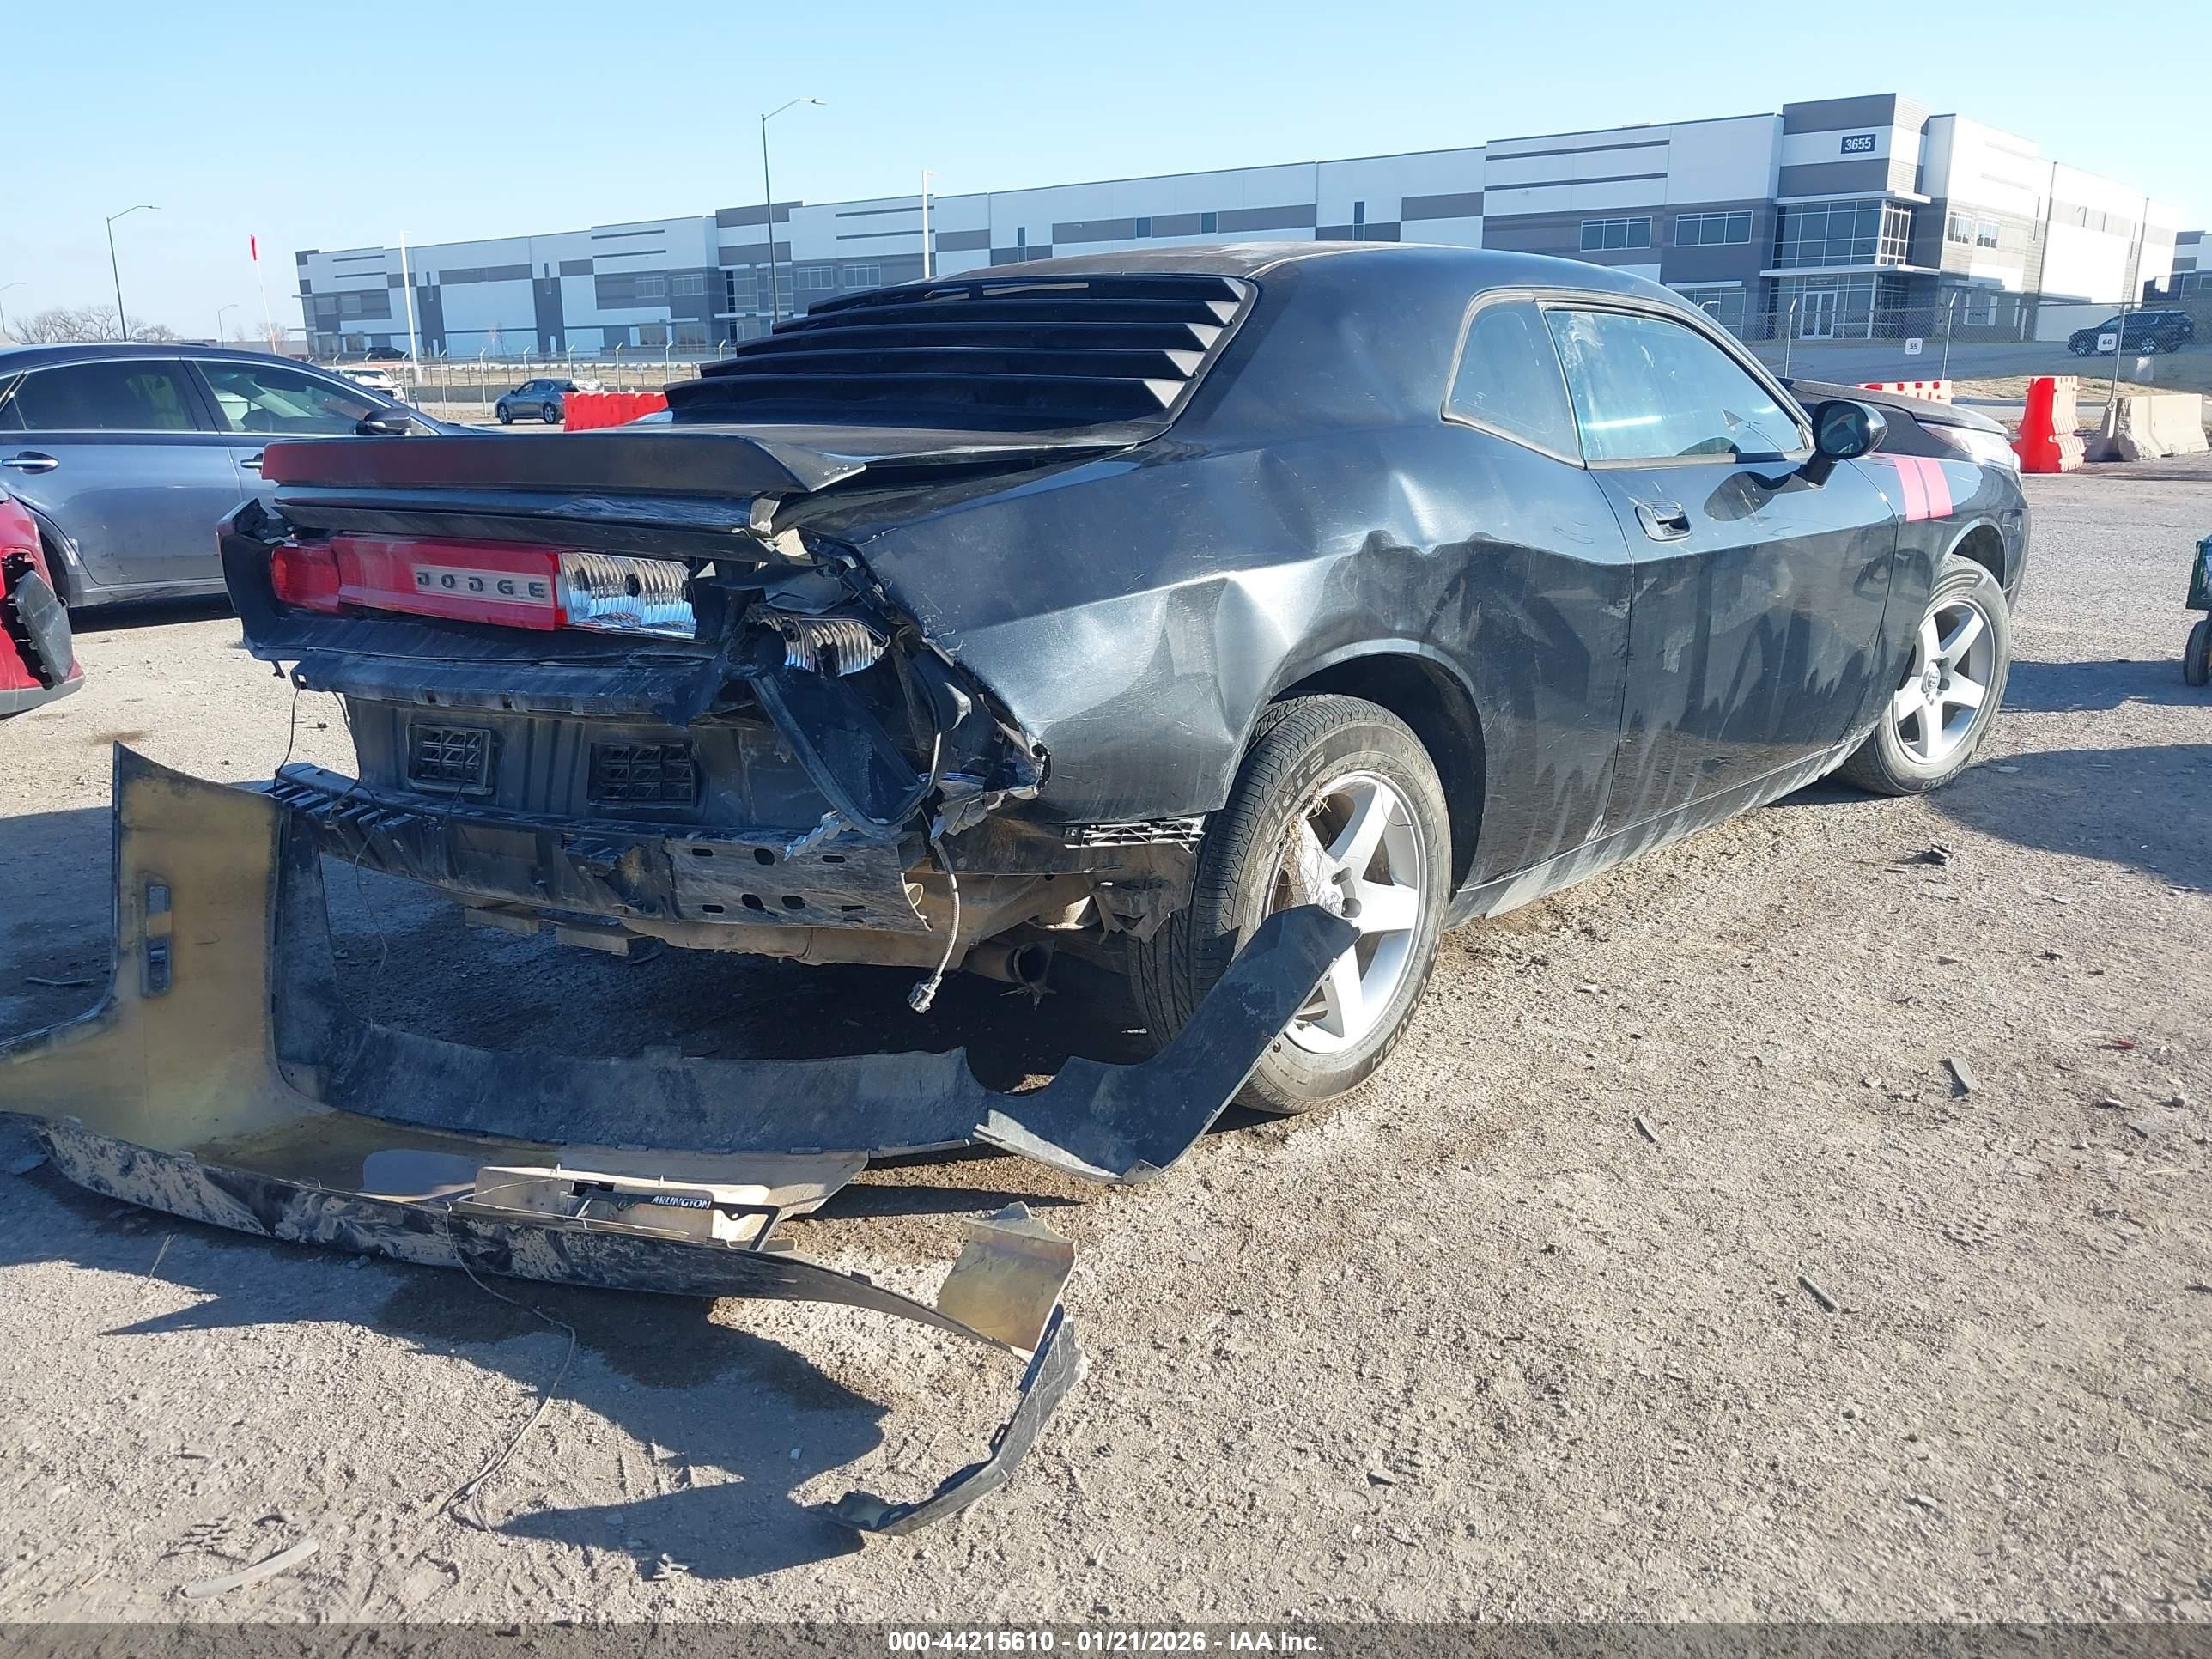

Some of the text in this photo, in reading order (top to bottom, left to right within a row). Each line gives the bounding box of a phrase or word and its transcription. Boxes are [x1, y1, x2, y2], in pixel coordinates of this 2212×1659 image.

[1844, 137, 1872, 151] 3655
[416, 571, 545, 599] DODGE
[652, 1194, 712, 1209] ARLINGTON
